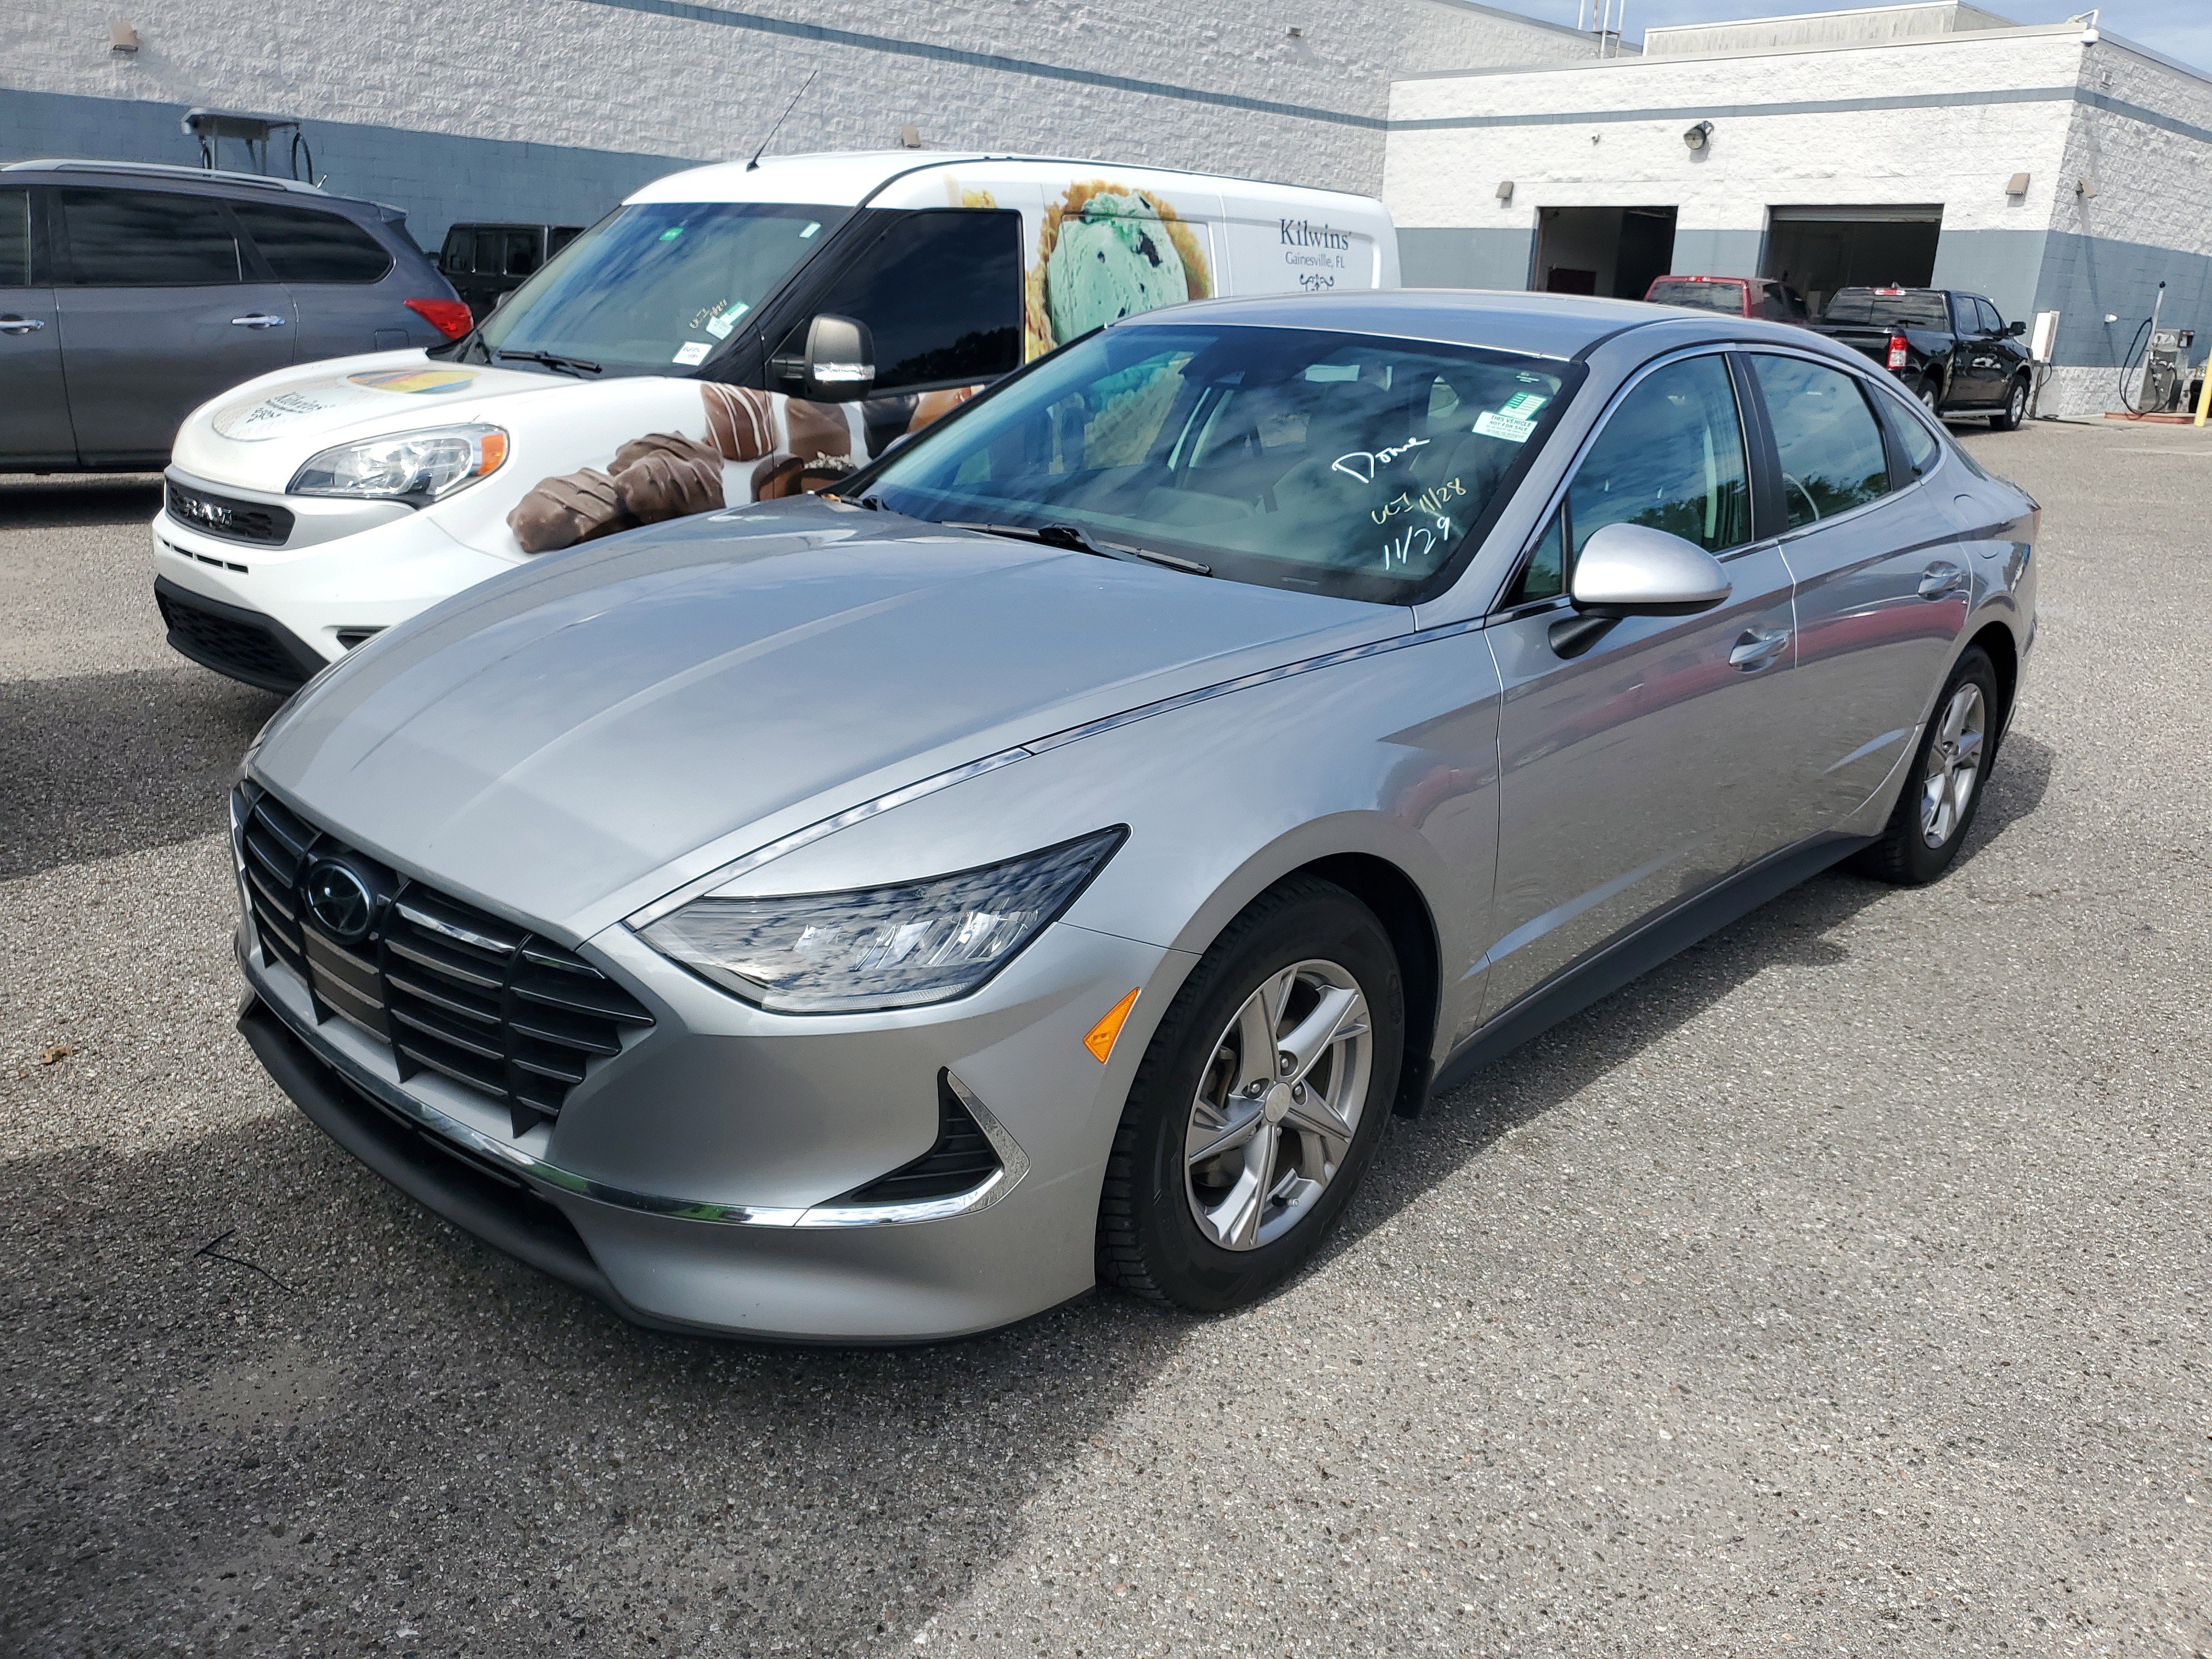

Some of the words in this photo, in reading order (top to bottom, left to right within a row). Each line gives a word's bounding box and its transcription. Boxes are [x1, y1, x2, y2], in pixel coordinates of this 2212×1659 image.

[1335, 255, 1345, 268] FL
[1506, 417, 1532, 427] VEHICLE
[1419, 477, 1467, 514] 11/28
[1384, 516, 1451, 571] 11/29
